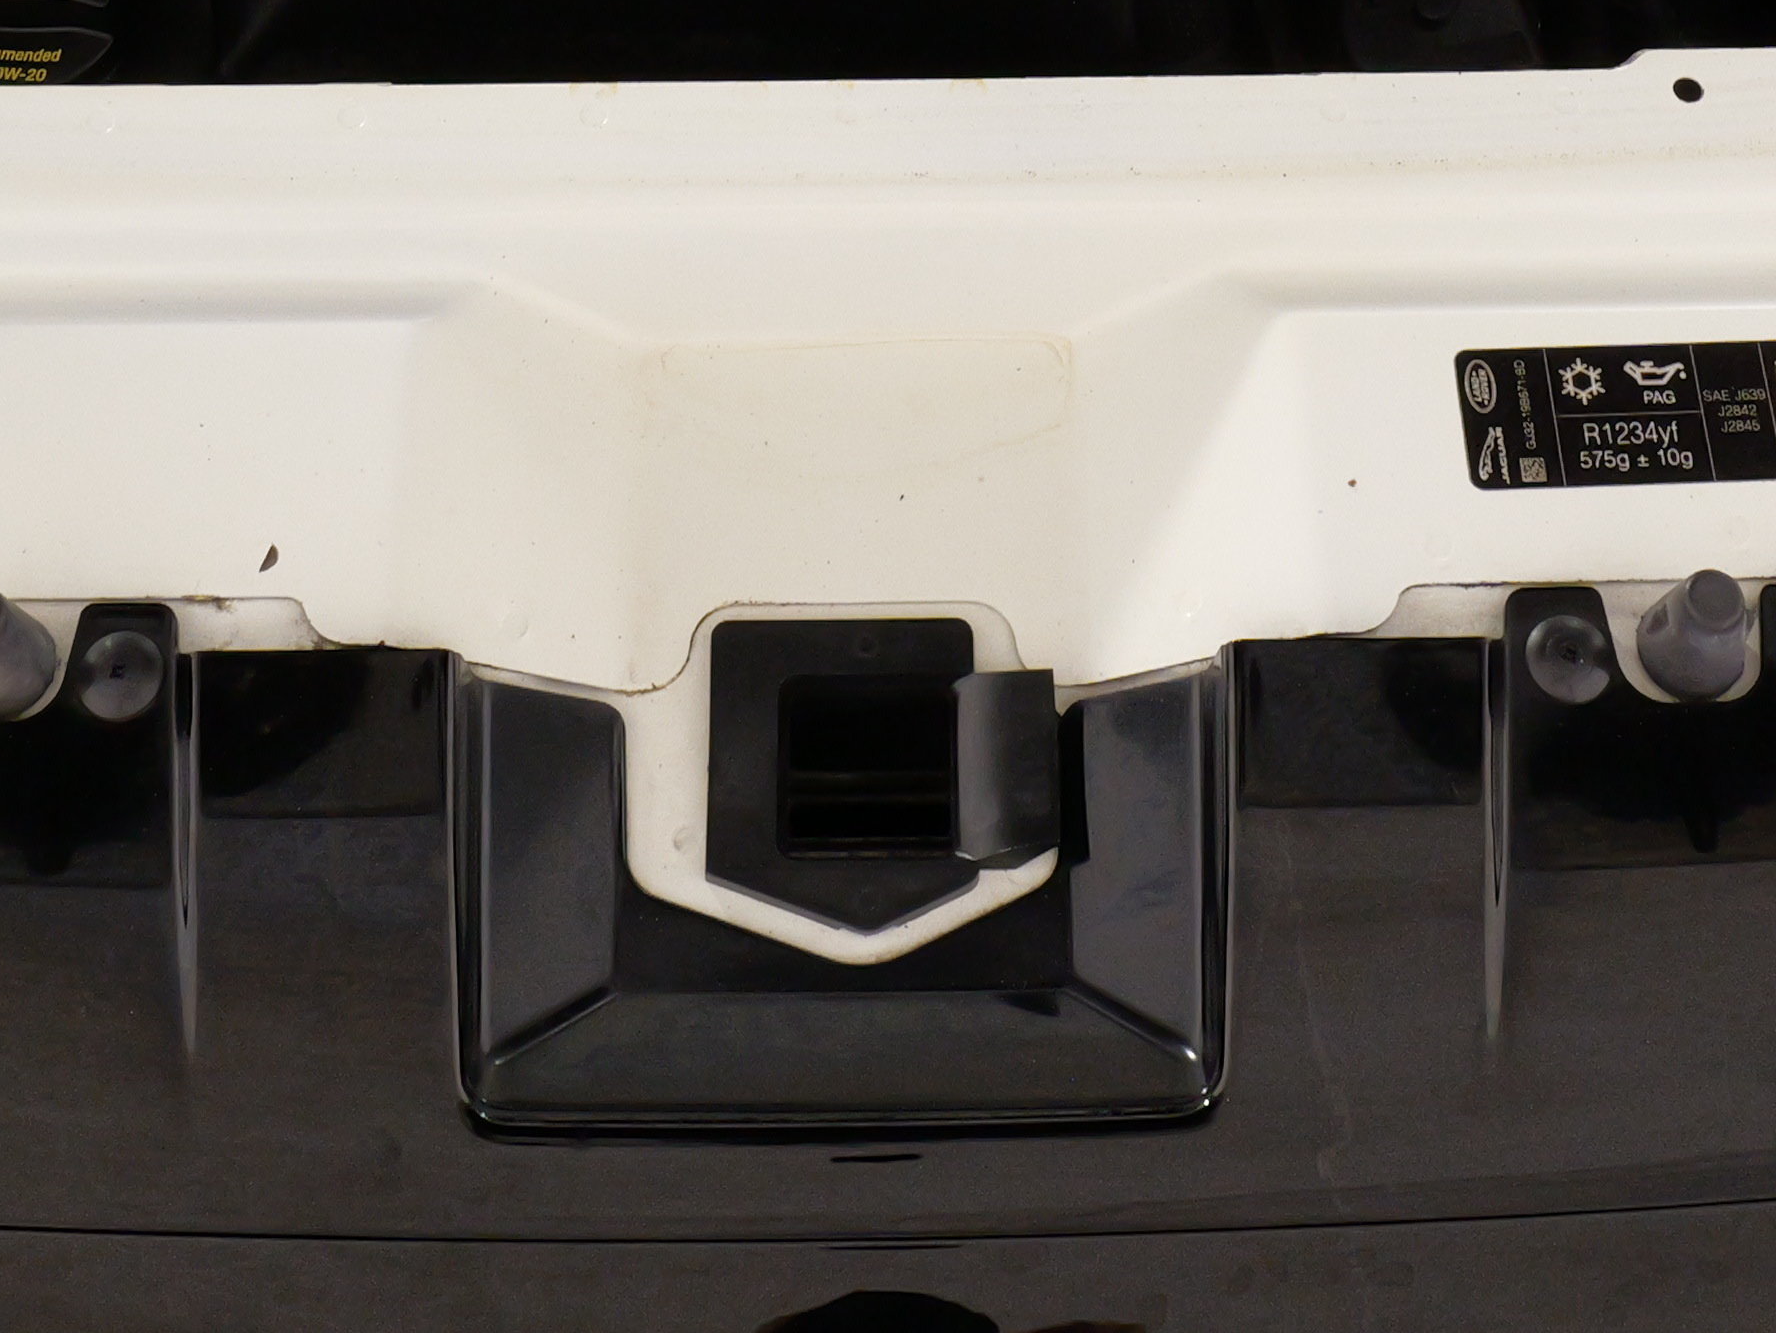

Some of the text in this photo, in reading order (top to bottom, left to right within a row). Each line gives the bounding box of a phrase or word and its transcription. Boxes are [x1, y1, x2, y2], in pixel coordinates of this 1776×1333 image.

[1643, 389, 1677, 405] PAG
[1703, 387, 1767, 402] SAE J639
[1717, 404, 1758, 419] J2842
[1720, 420, 1761, 434] J2845
[1582, 421, 1680, 449] R1234yf
[1579, 449, 1631, 473] 575g
[1657, 447, 1694, 471] 10g
